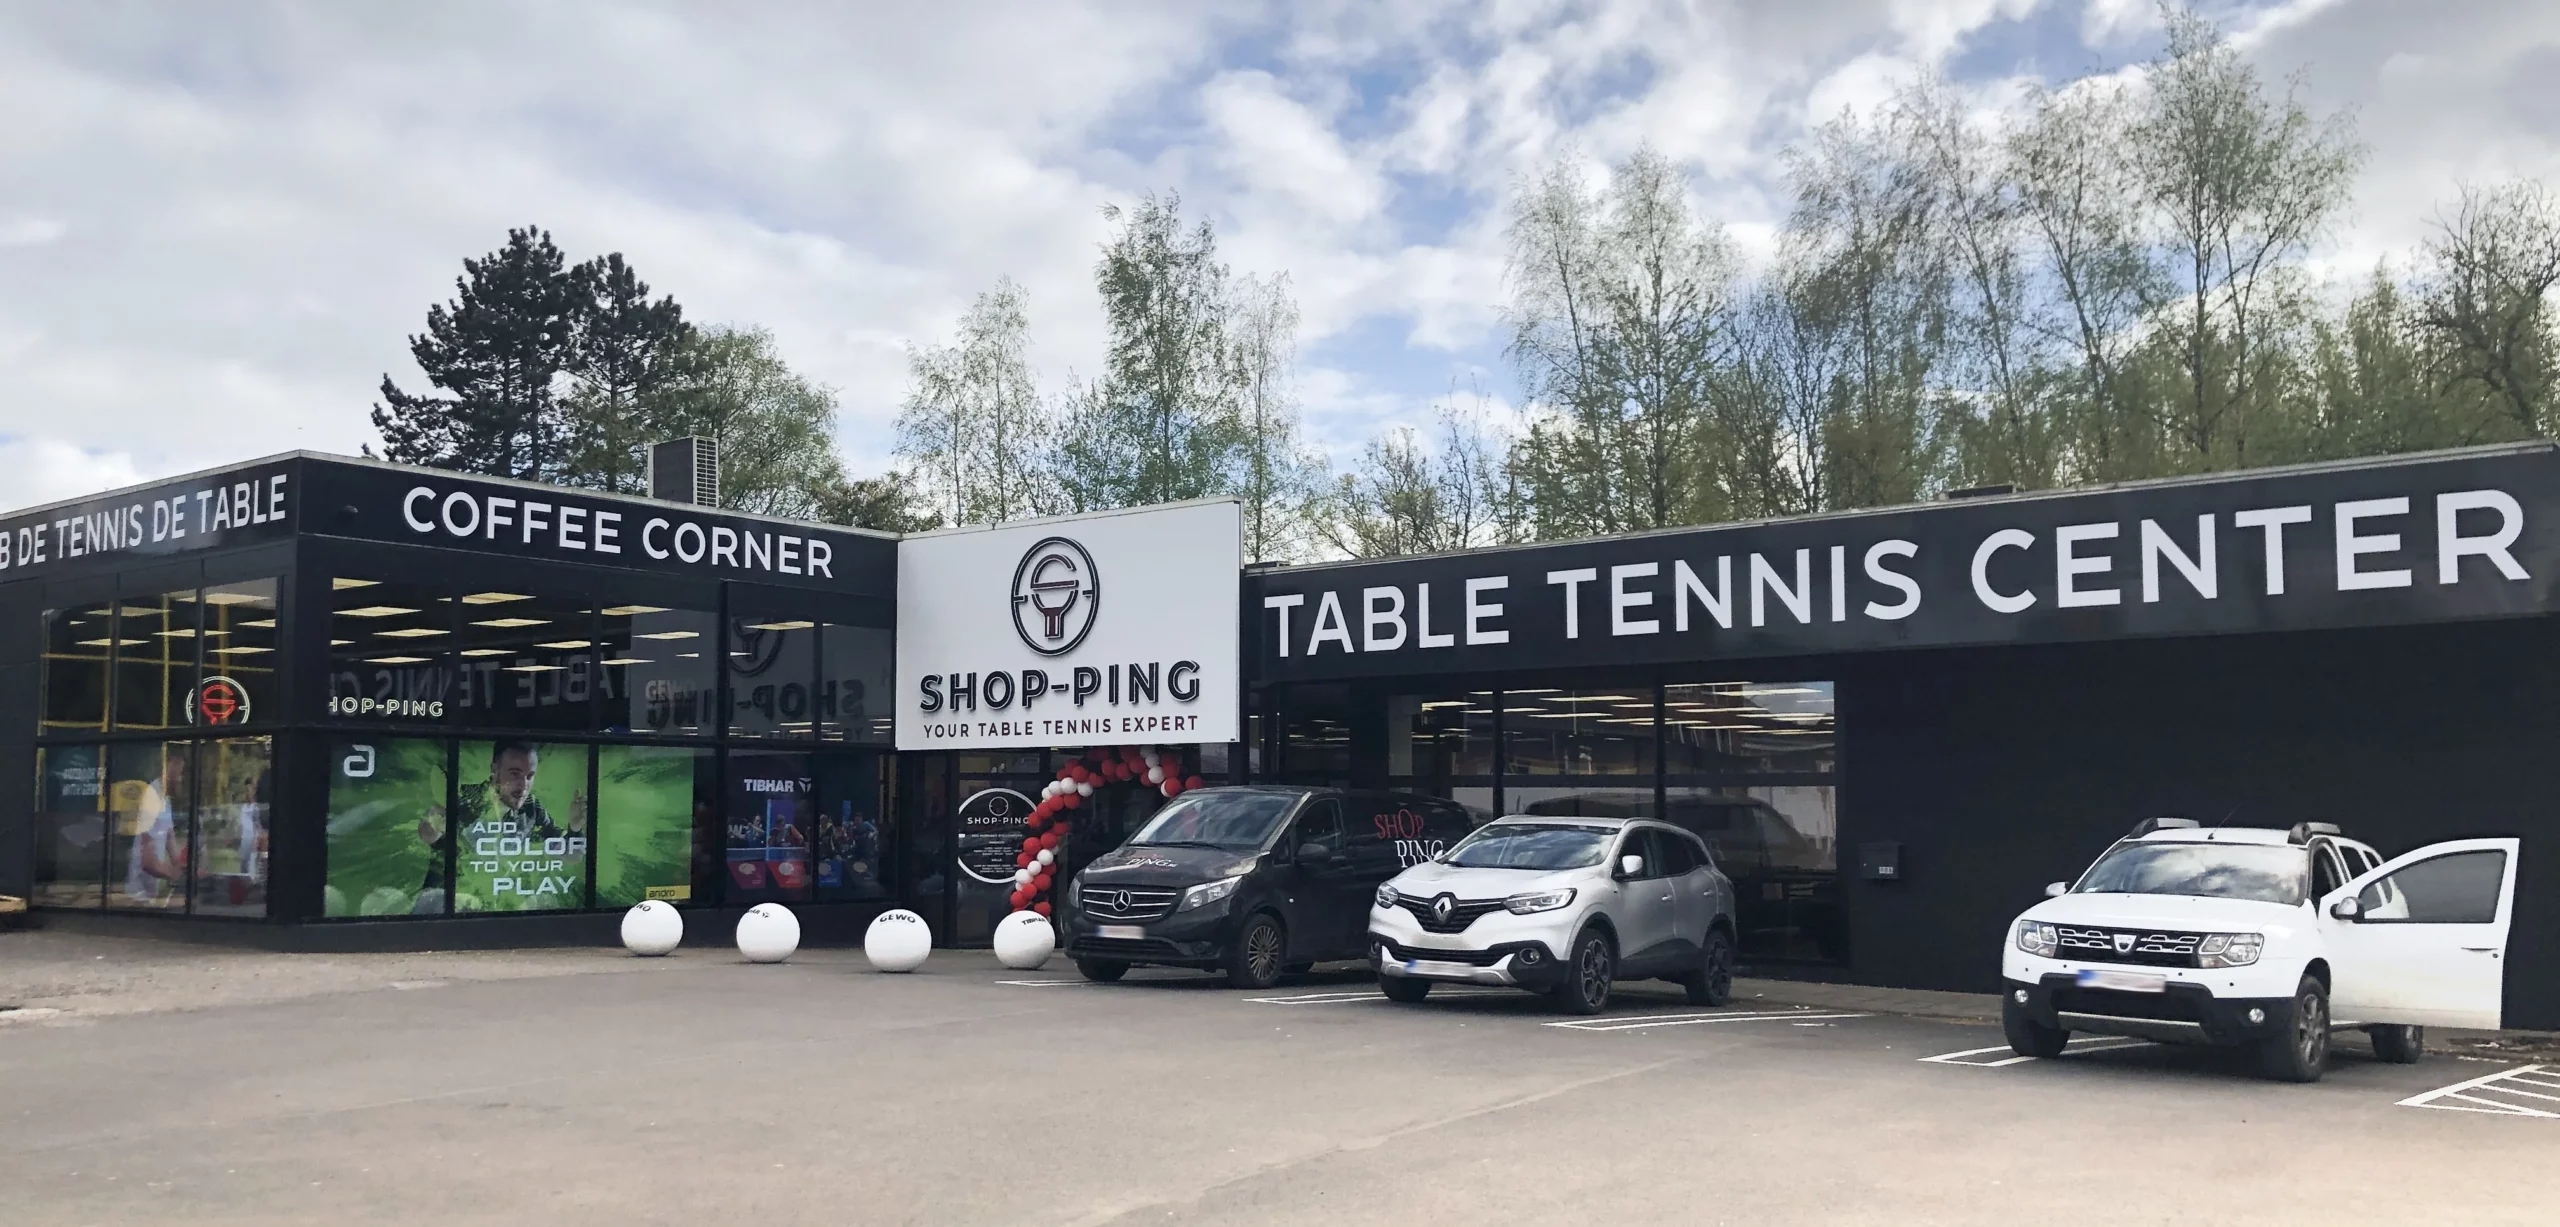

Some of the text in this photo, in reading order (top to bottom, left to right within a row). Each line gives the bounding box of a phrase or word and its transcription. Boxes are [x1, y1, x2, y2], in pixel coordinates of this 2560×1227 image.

[18, 523, 48, 567] DE
[55, 504, 143, 559] TENNIS
[152, 494, 188, 543] DE
[196, 474, 288, 533] TABLE
[403, 486, 833, 579] COFFEE CORNER
[1264, 488, 2531, 659] TABLE TENNIS CENTER
[919, 660, 1201, 712] SHOP-PING
[924, 715, 1199, 739] YOUR TABLE TENNIS EXPERT
[744, 778, 794, 792] TIBHAR
[471, 821, 517, 833] ADD
[1374, 809, 1424, 839] SHOP
[476, 837, 587, 855] COLOR
[470, 860, 564, 873] TO YOUR
[493, 876, 576, 895] PLAY
[648, 889, 676, 898] andro
[879, 914, 916, 923] GEWO
